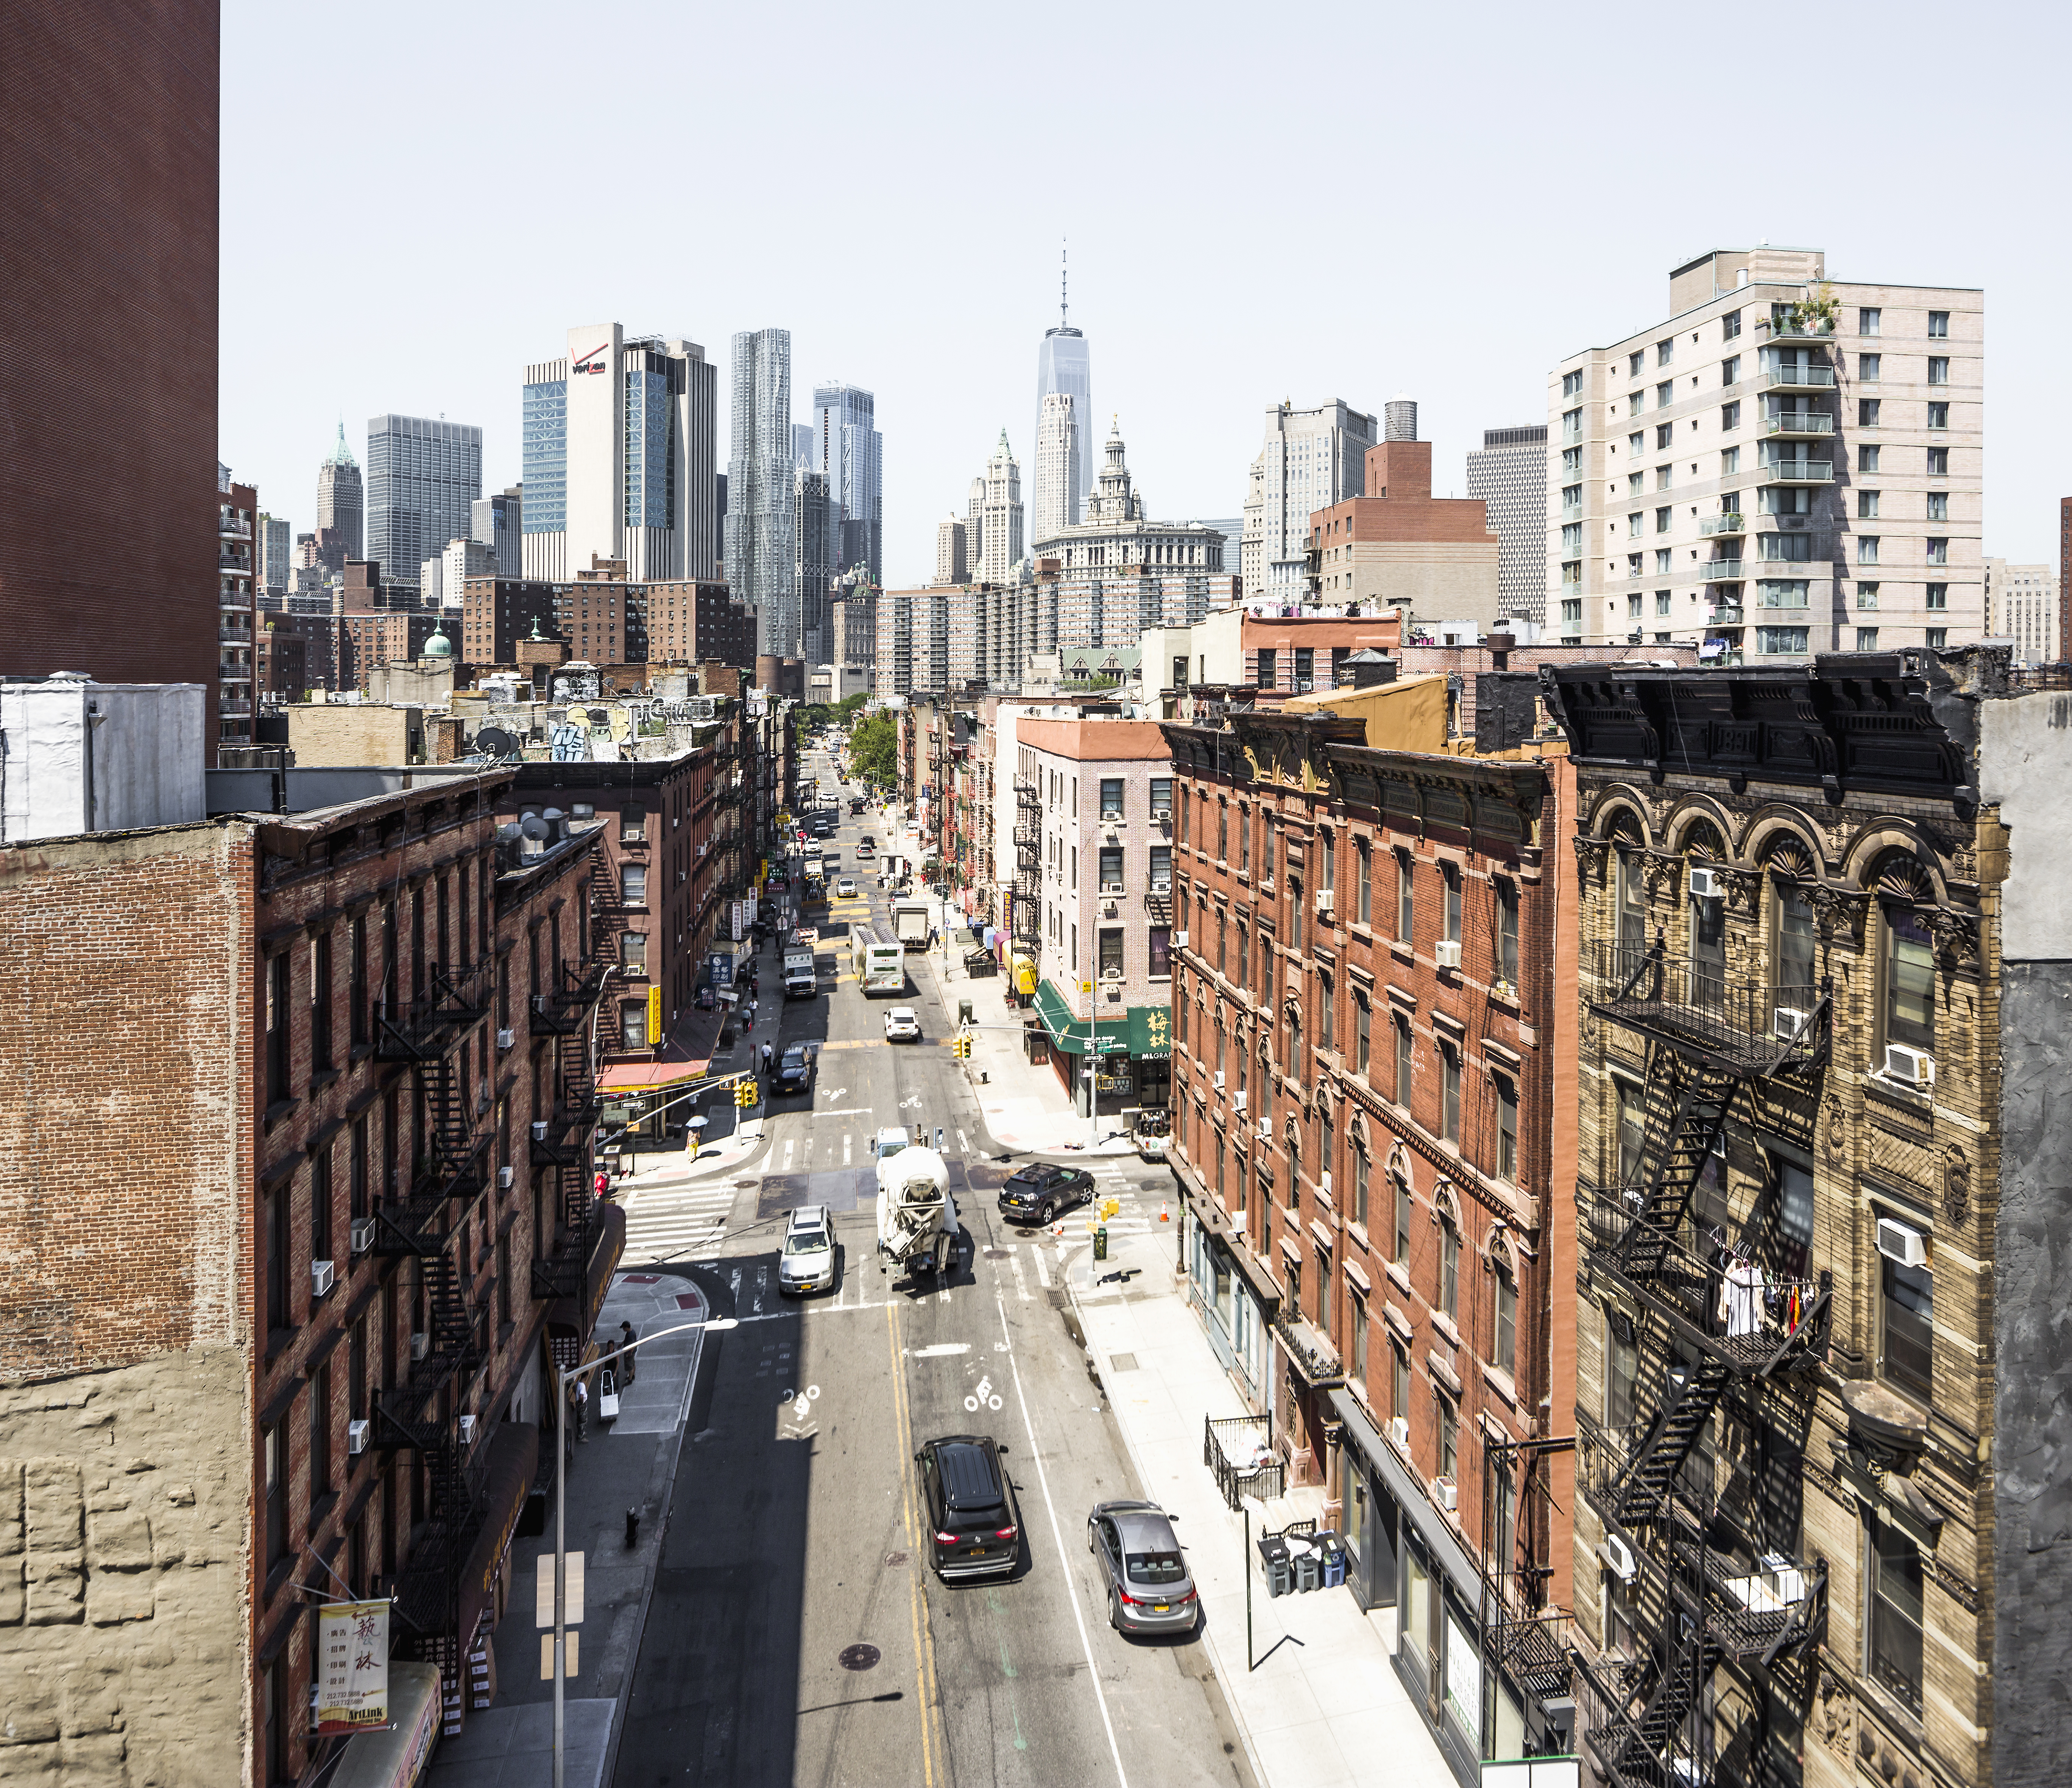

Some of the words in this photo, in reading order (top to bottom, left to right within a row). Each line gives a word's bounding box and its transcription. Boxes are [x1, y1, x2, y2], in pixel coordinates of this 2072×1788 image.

[572, 361, 605, 373] verizon
[1147, 1010, 1170, 1048] 梅林
[330, 1660, 346, 1669] 印刷
[1450, 1694, 1459, 1714] 212
[1462, 1697, 1477, 1727] BASEMENT
[1472, 1700, 1476, 1716] FT
[348, 1707, 382, 1720] ArtLink
